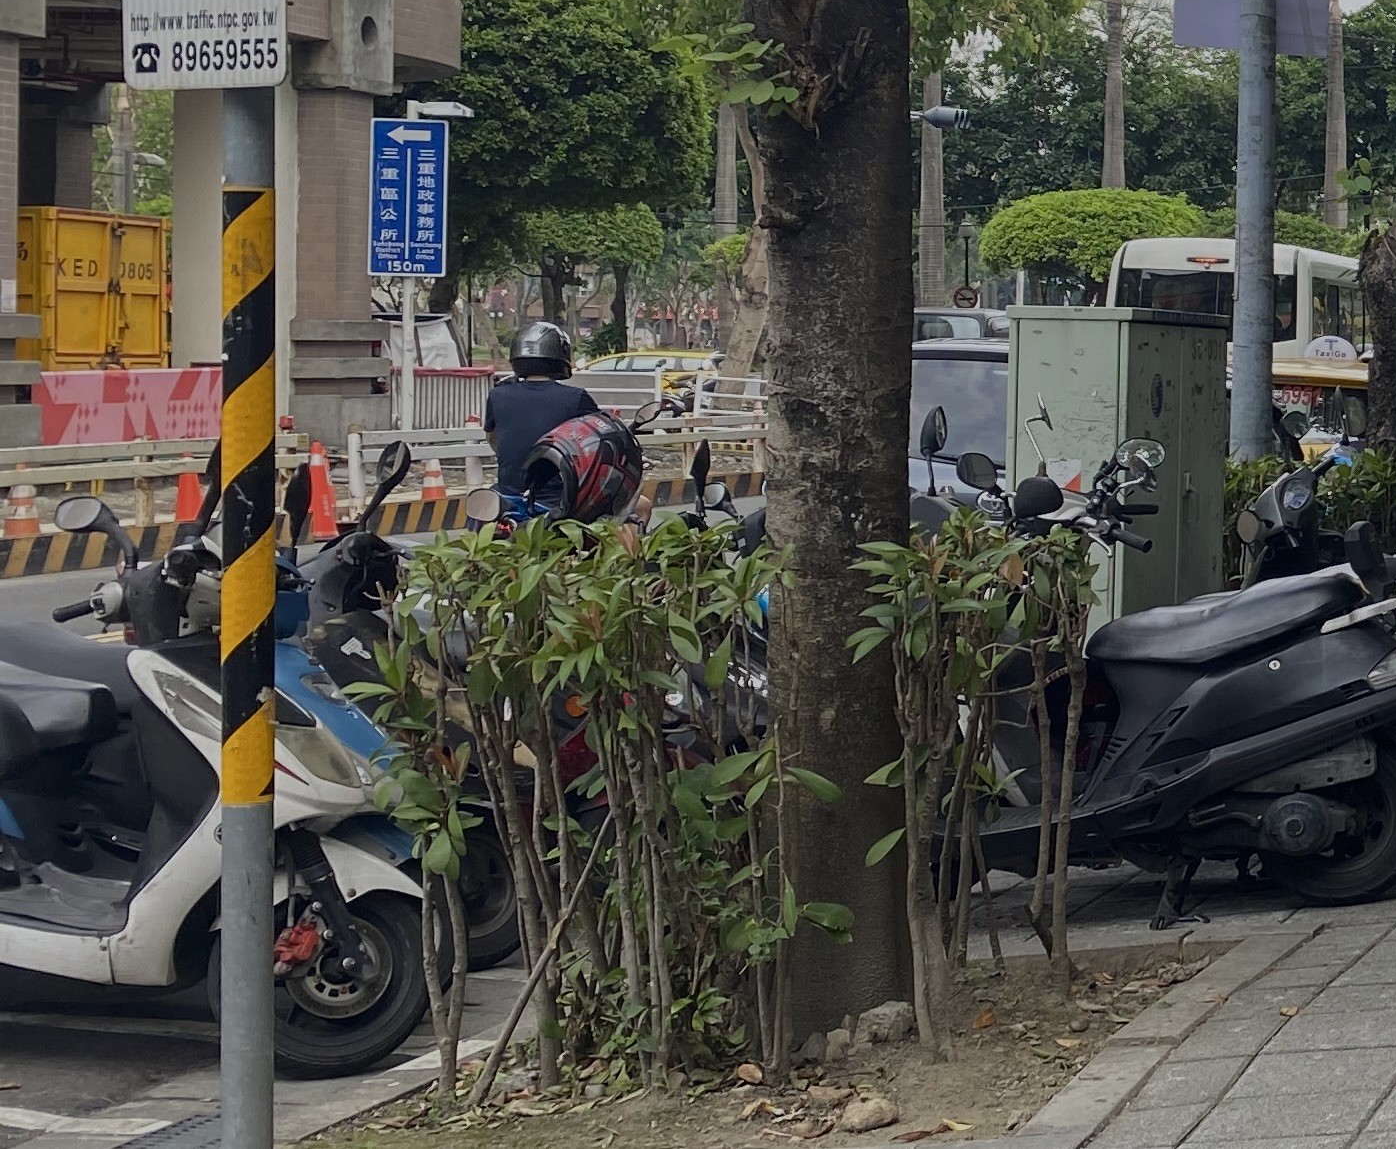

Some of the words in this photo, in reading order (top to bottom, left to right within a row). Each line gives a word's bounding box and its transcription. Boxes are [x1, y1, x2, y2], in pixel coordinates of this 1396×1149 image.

[171, 37, 279, 72] 89659555
[379, 147, 400, 241] 三重區公所
[416, 149, 437, 242] 三重地政事務所
[57, 257, 98, 277] KED
[387, 260, 425, 272] 150m
